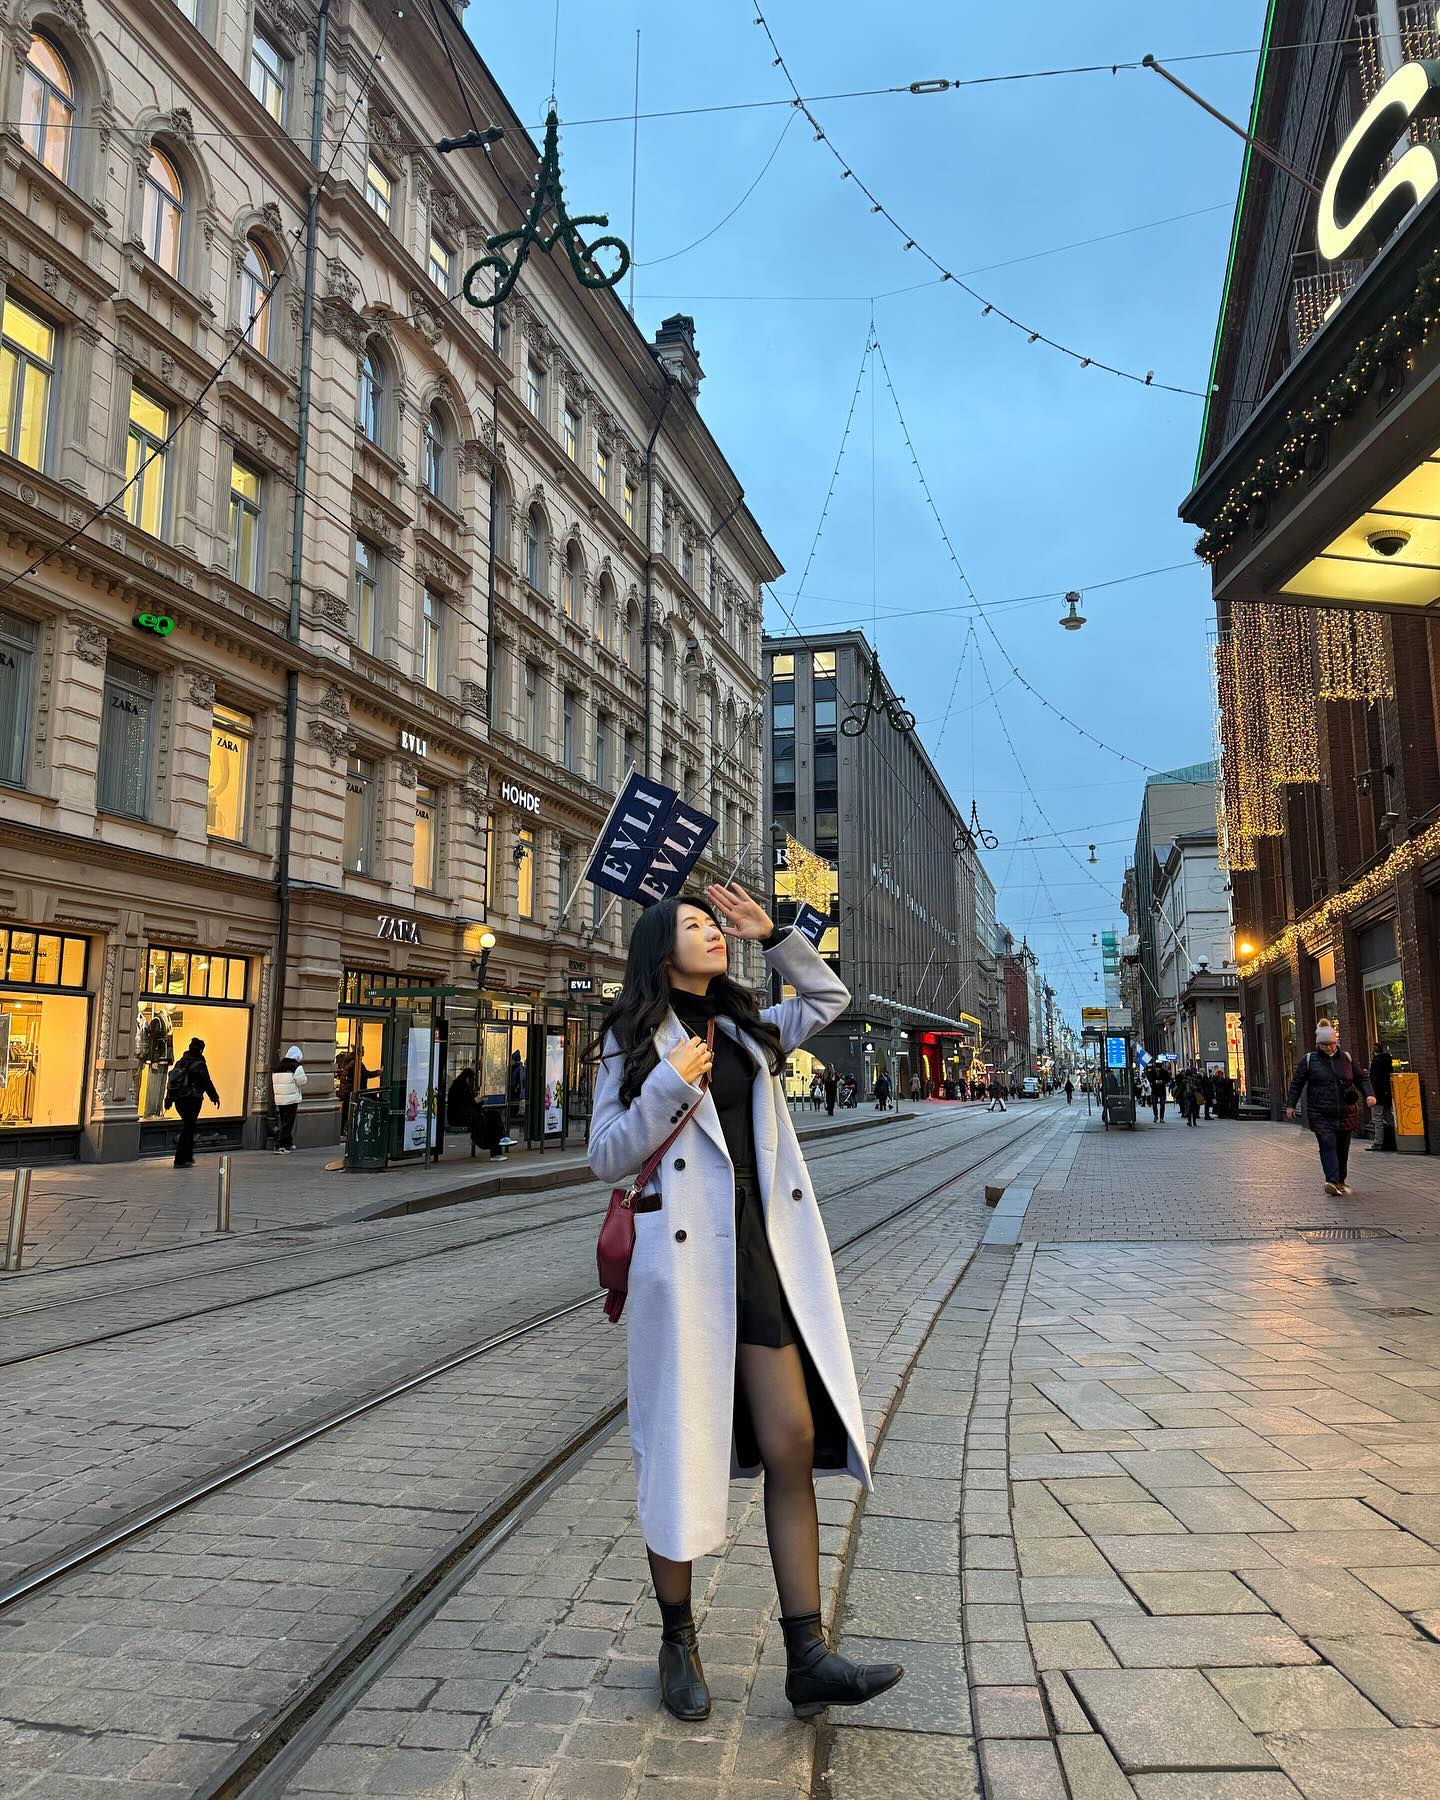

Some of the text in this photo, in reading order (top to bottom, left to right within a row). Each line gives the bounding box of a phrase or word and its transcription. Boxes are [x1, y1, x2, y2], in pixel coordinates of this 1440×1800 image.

[112, 696, 138, 716] ZARA
[217, 736, 239, 752] ZARA
[401, 730, 427, 757] EVLI
[346, 782, 363, 796] ZARA
[502, 781, 541, 815] HOHDE
[600, 789, 663, 883] EVLI
[638, 815, 704, 901] EVLI
[377, 915, 422, 945] ZARA
[800, 912, 823, 940] LI
[570, 980, 591, 989] EVLI
